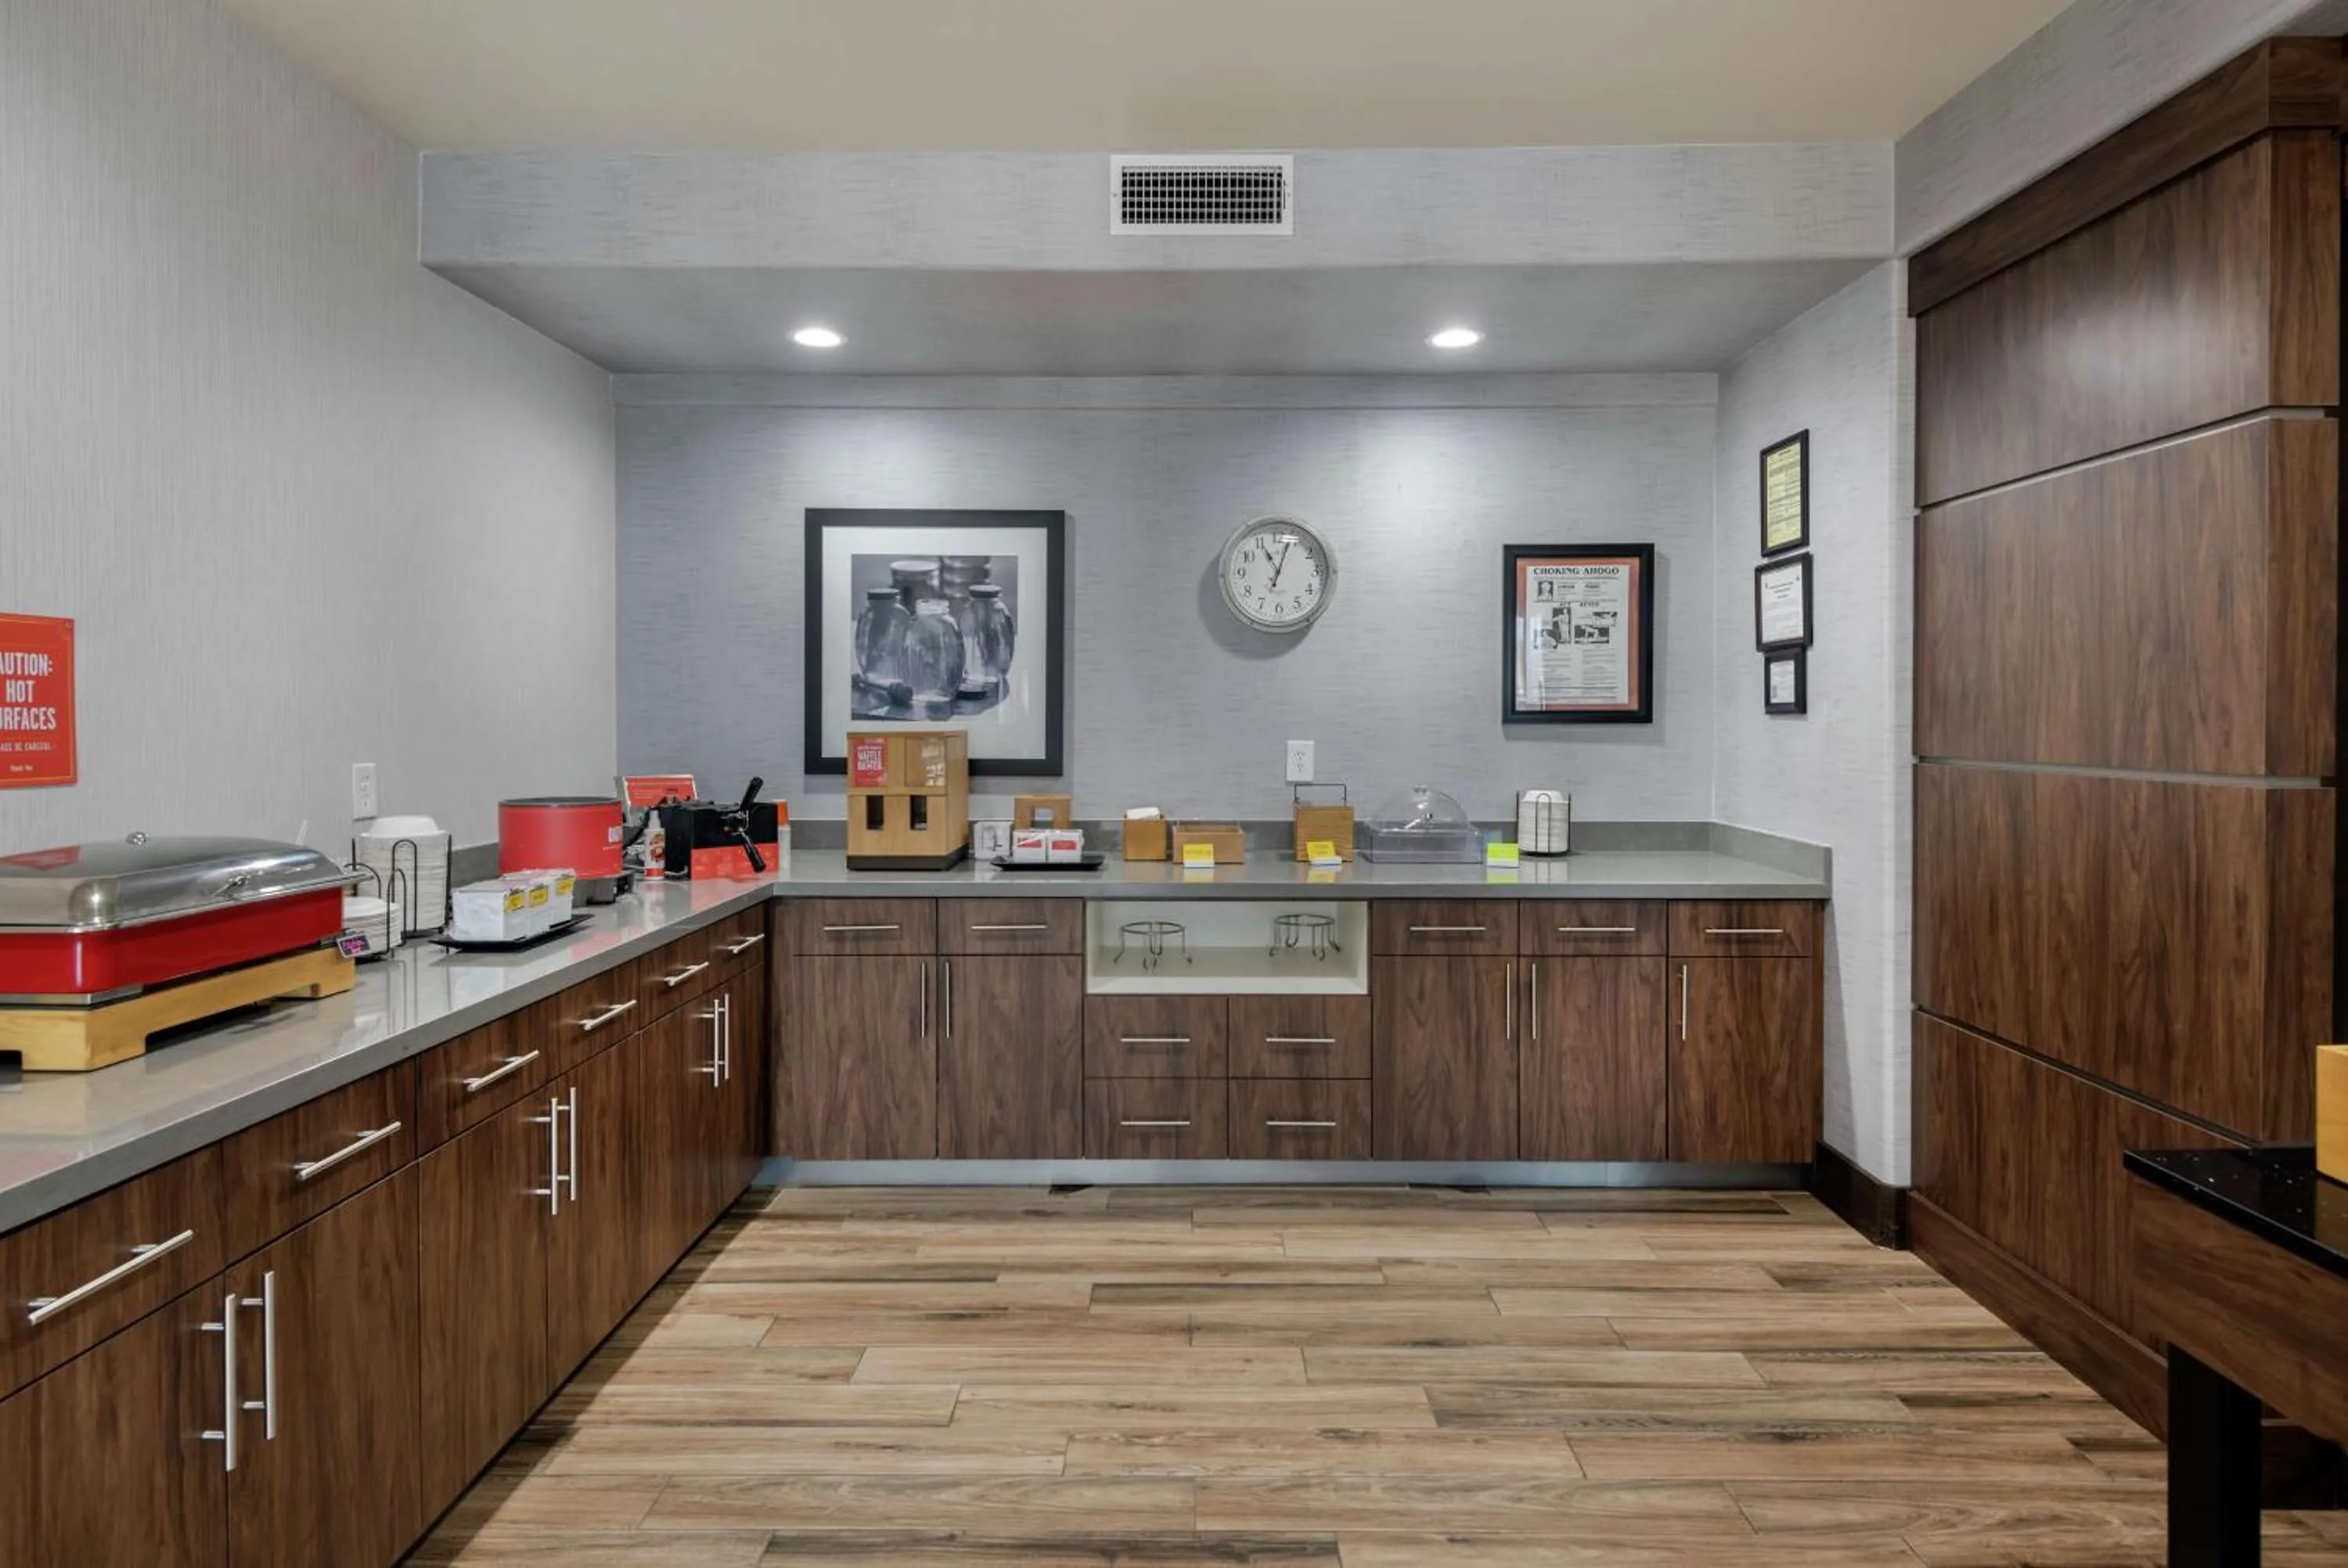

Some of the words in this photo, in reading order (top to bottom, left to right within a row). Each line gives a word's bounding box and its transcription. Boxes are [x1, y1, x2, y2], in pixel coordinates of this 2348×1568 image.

[1255, 536, 1264, 549] 11
[1237, 567, 1246, 580] 9
[1533, 566, 1579, 575] CHOKING
[1583, 566, 1619, 575] AHOGO
[1244, 584, 1252, 597] 8
[1304, 582, 1314, 595] 4
[1257, 596, 1266, 610] 7
[1274, 602, 1284, 614] 6
[1292, 596, 1302, 609] 5
[6, 679, 35, 703] HOT
